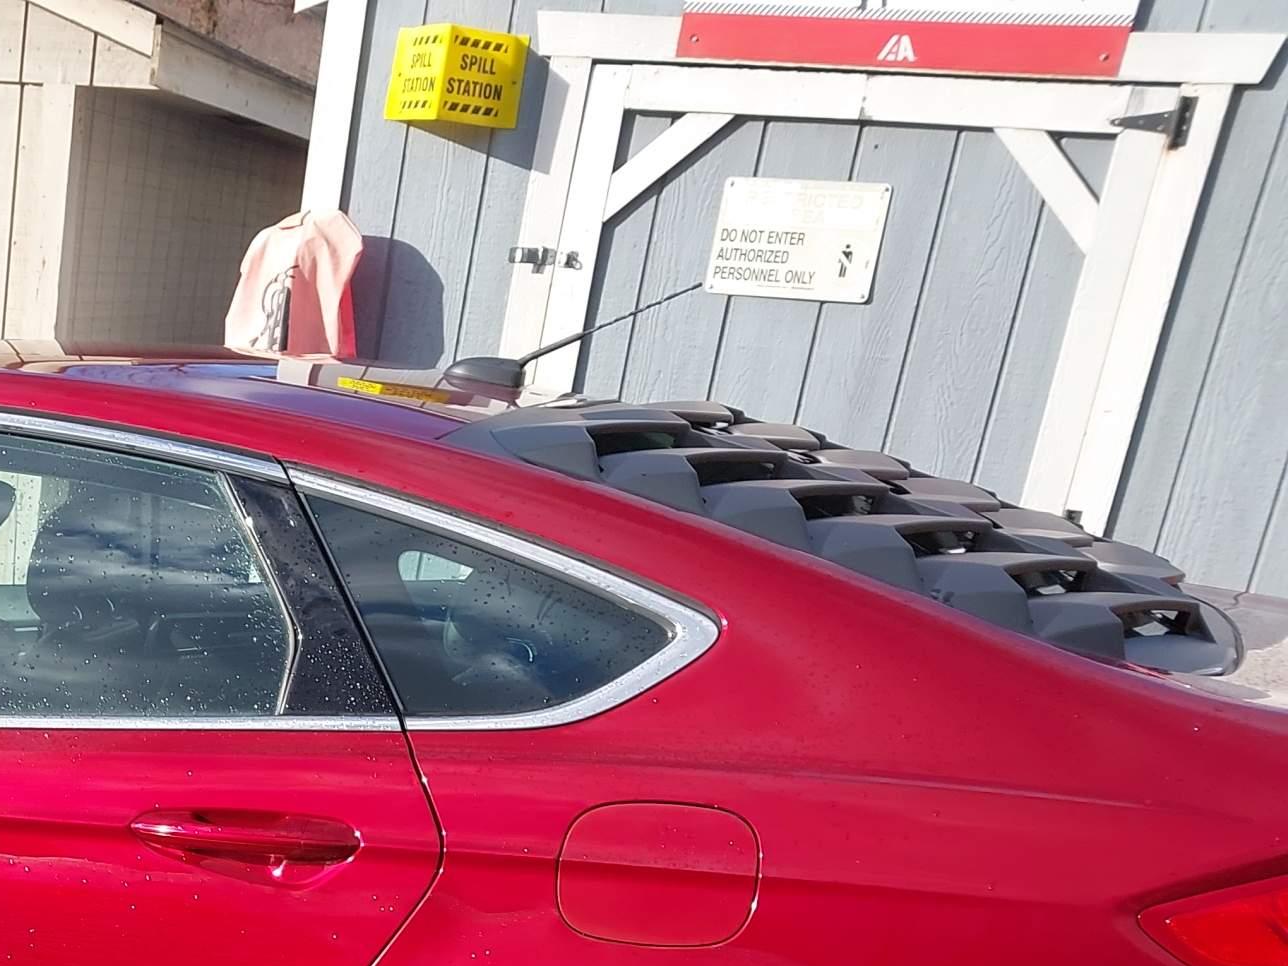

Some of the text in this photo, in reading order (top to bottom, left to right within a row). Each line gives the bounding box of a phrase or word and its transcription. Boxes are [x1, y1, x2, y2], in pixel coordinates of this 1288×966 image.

[411, 52, 432, 69] SPILL
[459, 53, 497, 76] SPILL
[402, 76, 436, 93] STATION
[446, 77, 503, 101] STATION
[720, 228, 805, 246] DO NOT ENTER
[716, 247, 790, 264] AUTHORIZED
[713, 265, 816, 285] PERSONNEL ONLY
